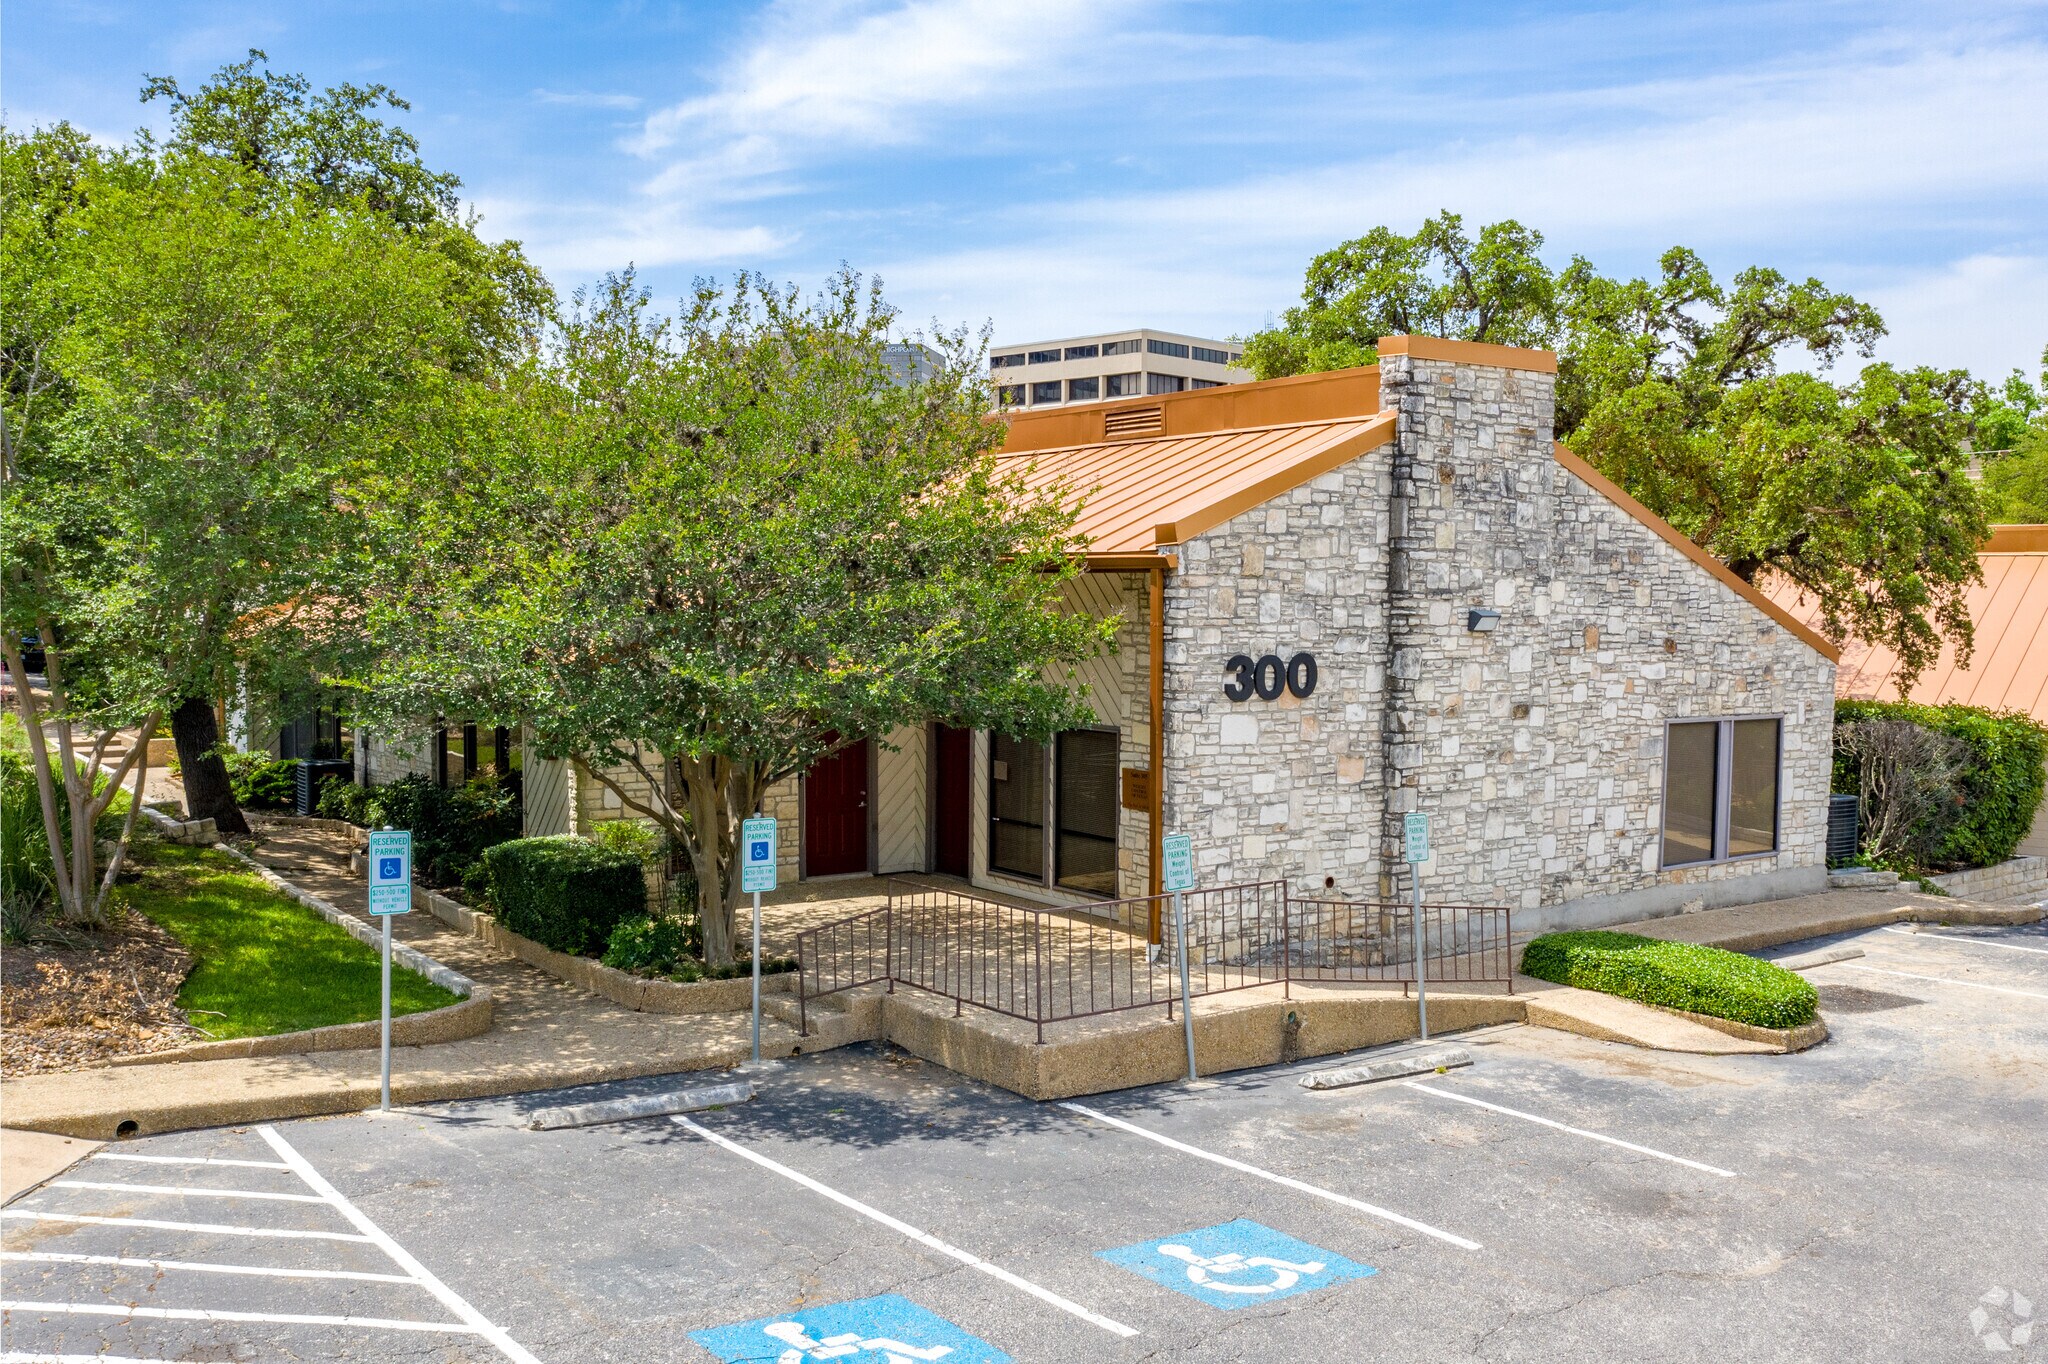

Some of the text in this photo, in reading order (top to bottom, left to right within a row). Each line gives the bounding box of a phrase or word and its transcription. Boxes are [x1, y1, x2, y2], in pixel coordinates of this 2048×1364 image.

[1224, 653, 1318, 702] 300
[1408, 818, 1425, 826] RESERVED
[746, 823, 773, 831] RESERVED
[1409, 826, 1425, 834] PARKING
[747, 832, 772, 840] PARKING
[373, 837, 407, 846] RESERVED
[1166, 840, 1188, 849] RESERVED
[375, 847, 405, 856] PARKING
[1168, 849, 1188, 859] PARKING
[1172, 860, 1186, 868] Weight
